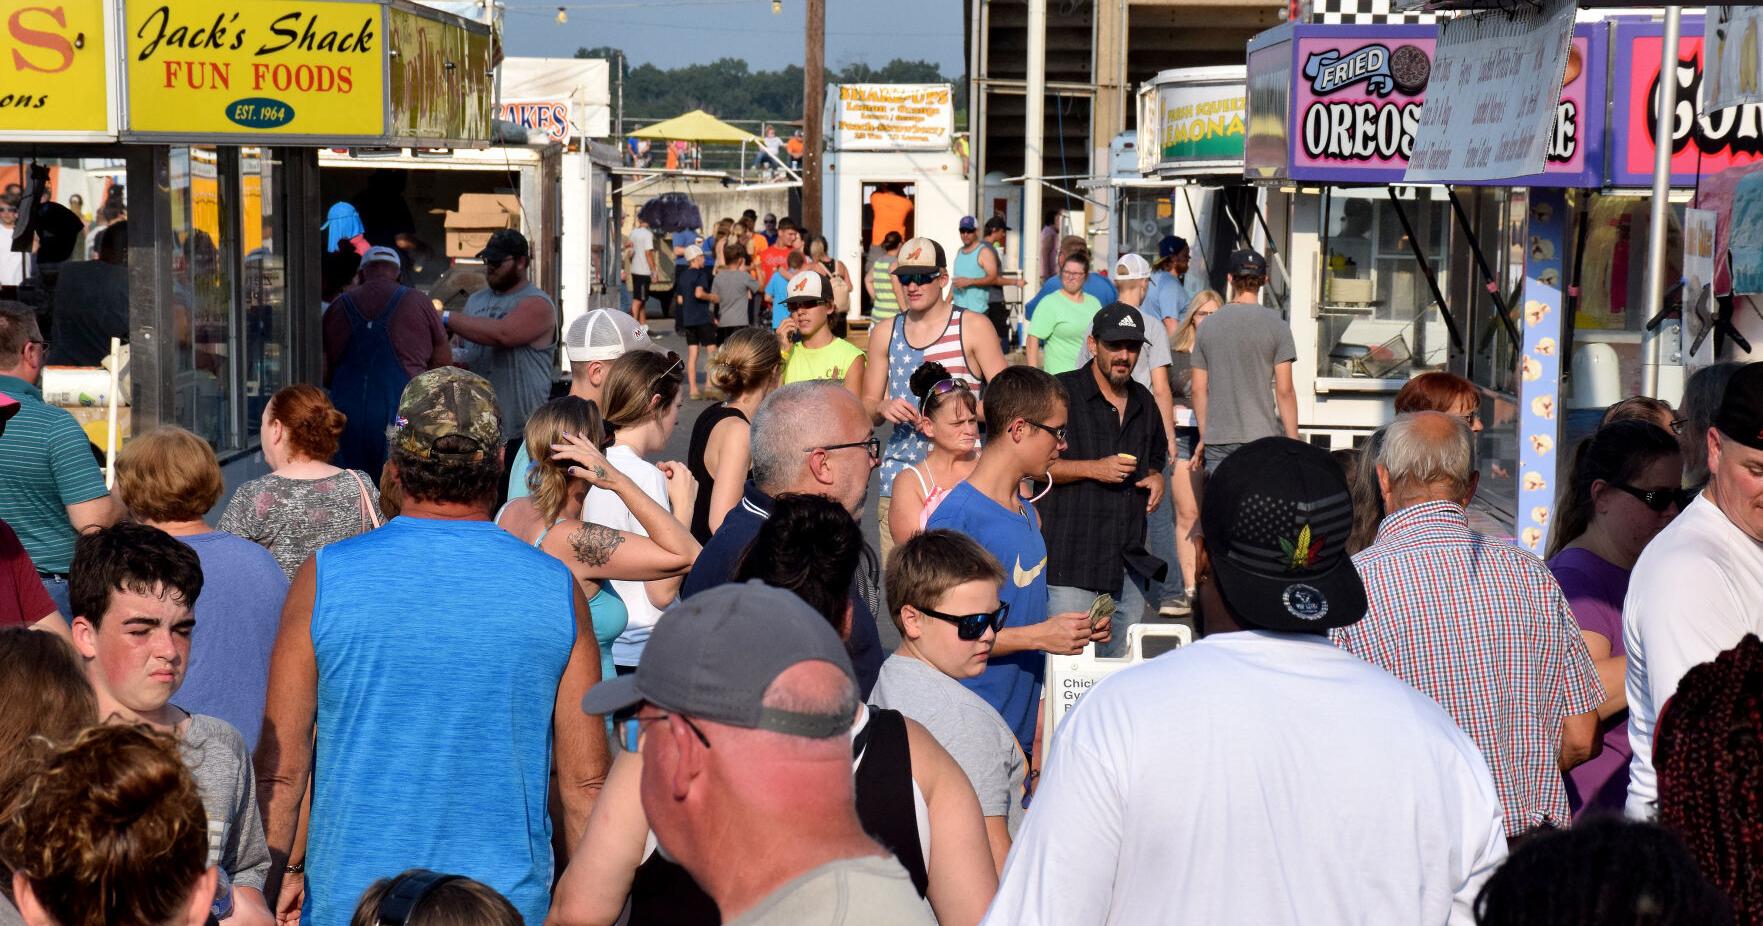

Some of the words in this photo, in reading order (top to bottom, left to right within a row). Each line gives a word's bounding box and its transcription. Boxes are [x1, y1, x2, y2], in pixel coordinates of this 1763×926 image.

[137, 6, 246, 61] Jack's
[254, 12, 374, 56] Shack
[163, 60, 231, 90] FUN
[252, 63, 353, 94] FOODS
[1321, 49, 1385, 88] FRIED
[234, 105, 257, 120] EST.
[260, 107, 286, 122] 1964
[500, 104, 565, 138] AKES
[1305, 103, 1421, 157] OREOS
[1063, 690, 1083, 701] Gy
